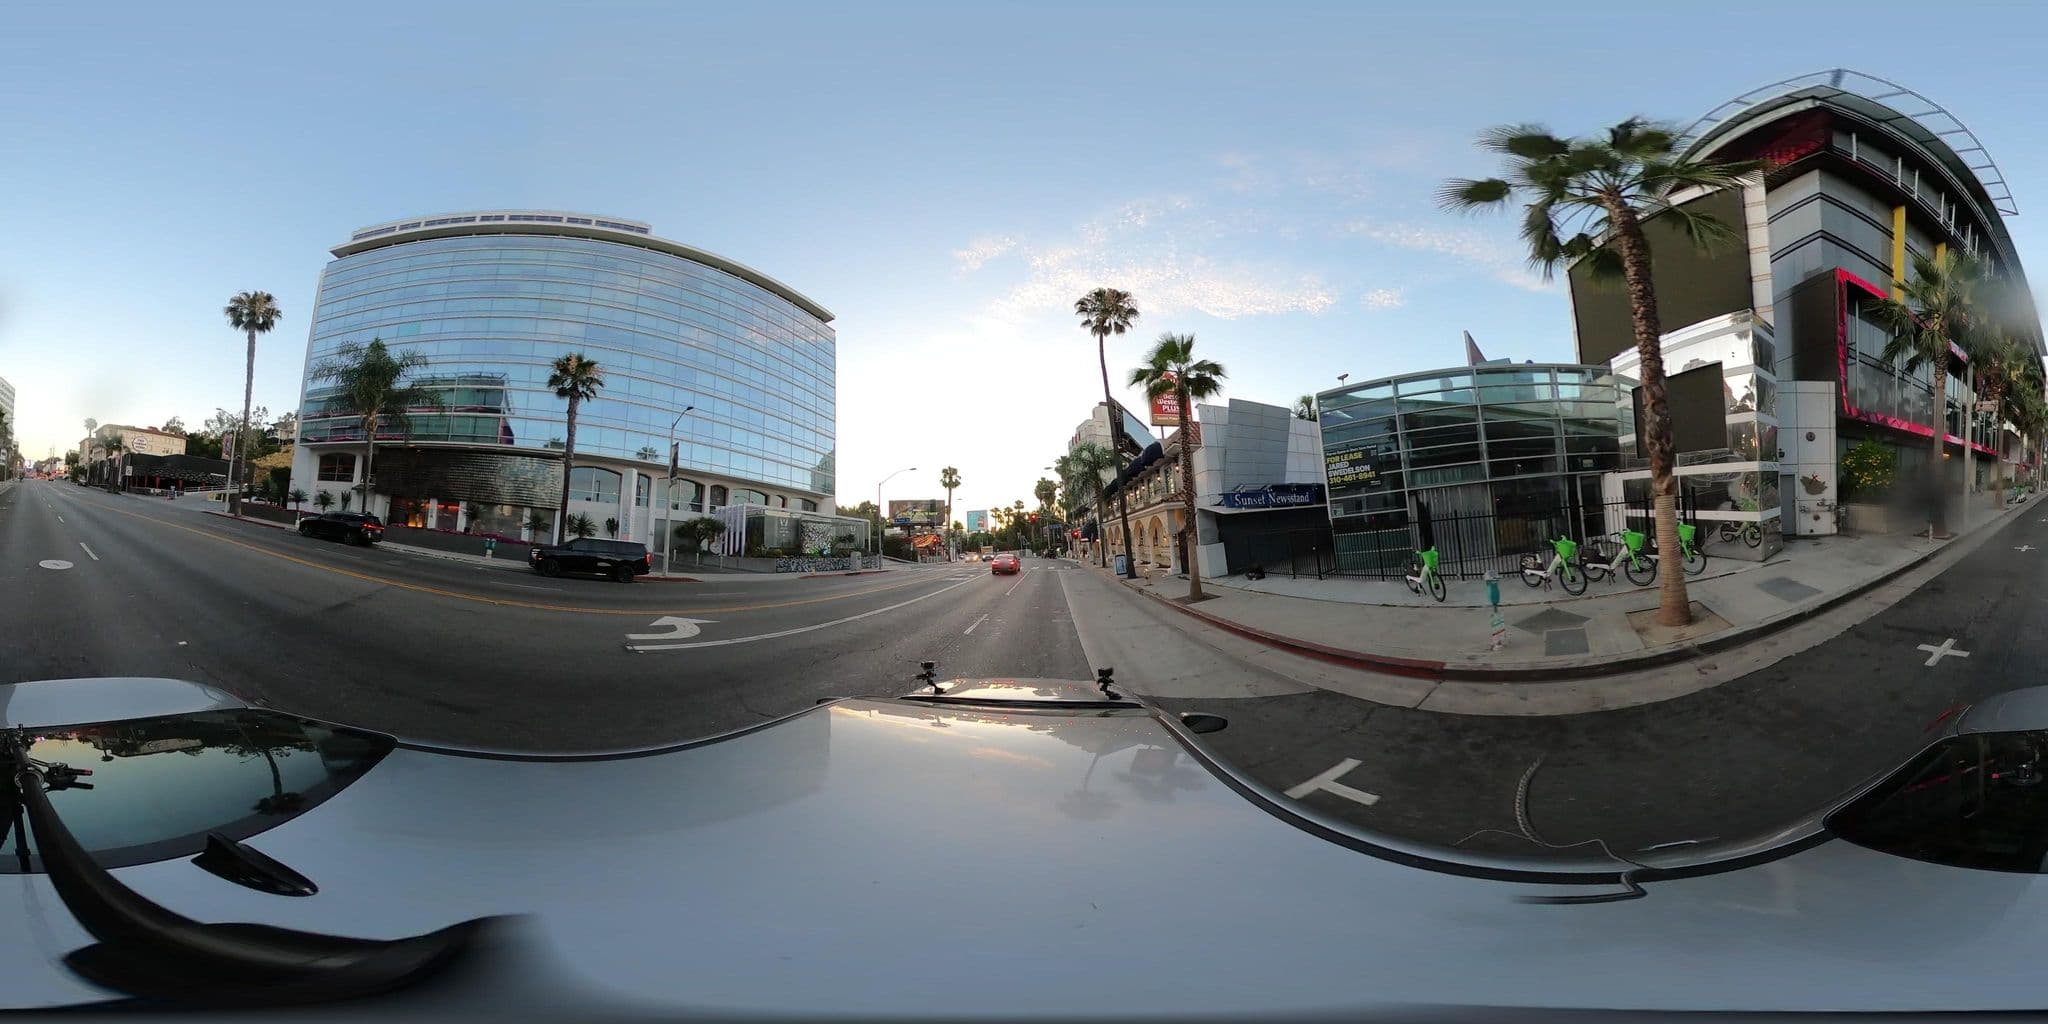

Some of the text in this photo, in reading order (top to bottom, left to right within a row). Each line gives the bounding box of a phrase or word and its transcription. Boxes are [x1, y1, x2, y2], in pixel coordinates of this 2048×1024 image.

[1327, 456, 1339, 464] FOR
[1341, 452, 1362, 461] LEASE
[1328, 461, 1349, 470] JARED
[1328, 464, 1371, 477] SWEDELSON
[1234, 491, 1309, 506] Sunset Newsstand
